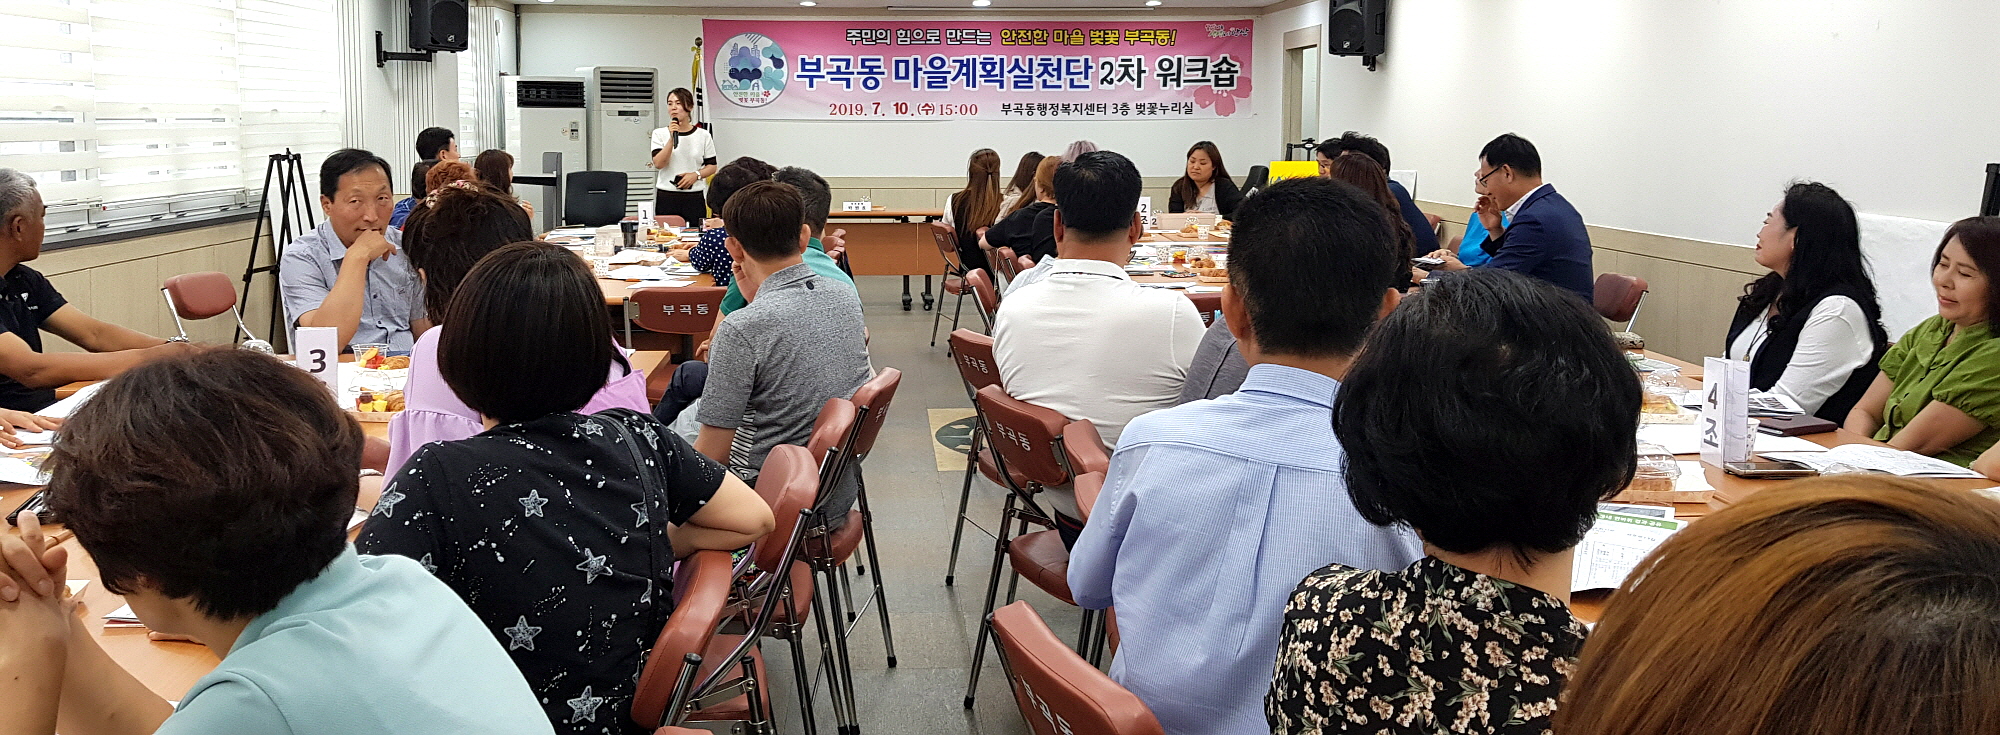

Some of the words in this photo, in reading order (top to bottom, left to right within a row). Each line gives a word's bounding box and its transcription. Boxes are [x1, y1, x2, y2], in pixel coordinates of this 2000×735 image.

[846, 29, 891, 45] 주민의
[896, 29, 941, 45] 힘으로
[946, 29, 991, 45] 만드는
[1000, 29, 1049, 45] 안전한
[1053, 29, 1085, 45] 마을
[1090, 29, 1120, 46] 벚꽃
[1124, 29, 1178, 46] 부곡동!
[796, 56, 886, 91] 부곡동
[894, 56, 1094, 90] 마을계획실천단
[1100, 57, 1147, 89] 2차
[1156, 56, 1239, 88] 워크숍
[829, 103, 867, 116] 2019.
[872, 102, 886, 116] 7.
[893, 102, 914, 116] 10.
[917, 103, 935, 115] (수)
[940, 103, 978, 116] 15:00
[1000, 103, 1107, 116] 부곡동행정복지센터
[1111, 103, 1131, 116] 3층
[1135, 102, 1194, 116] 벚꽃누리실
[662, 303, 709, 316] 부곡동
[962, 353, 989, 374] 부곡동
[995, 420, 1031, 452] 부곡동
